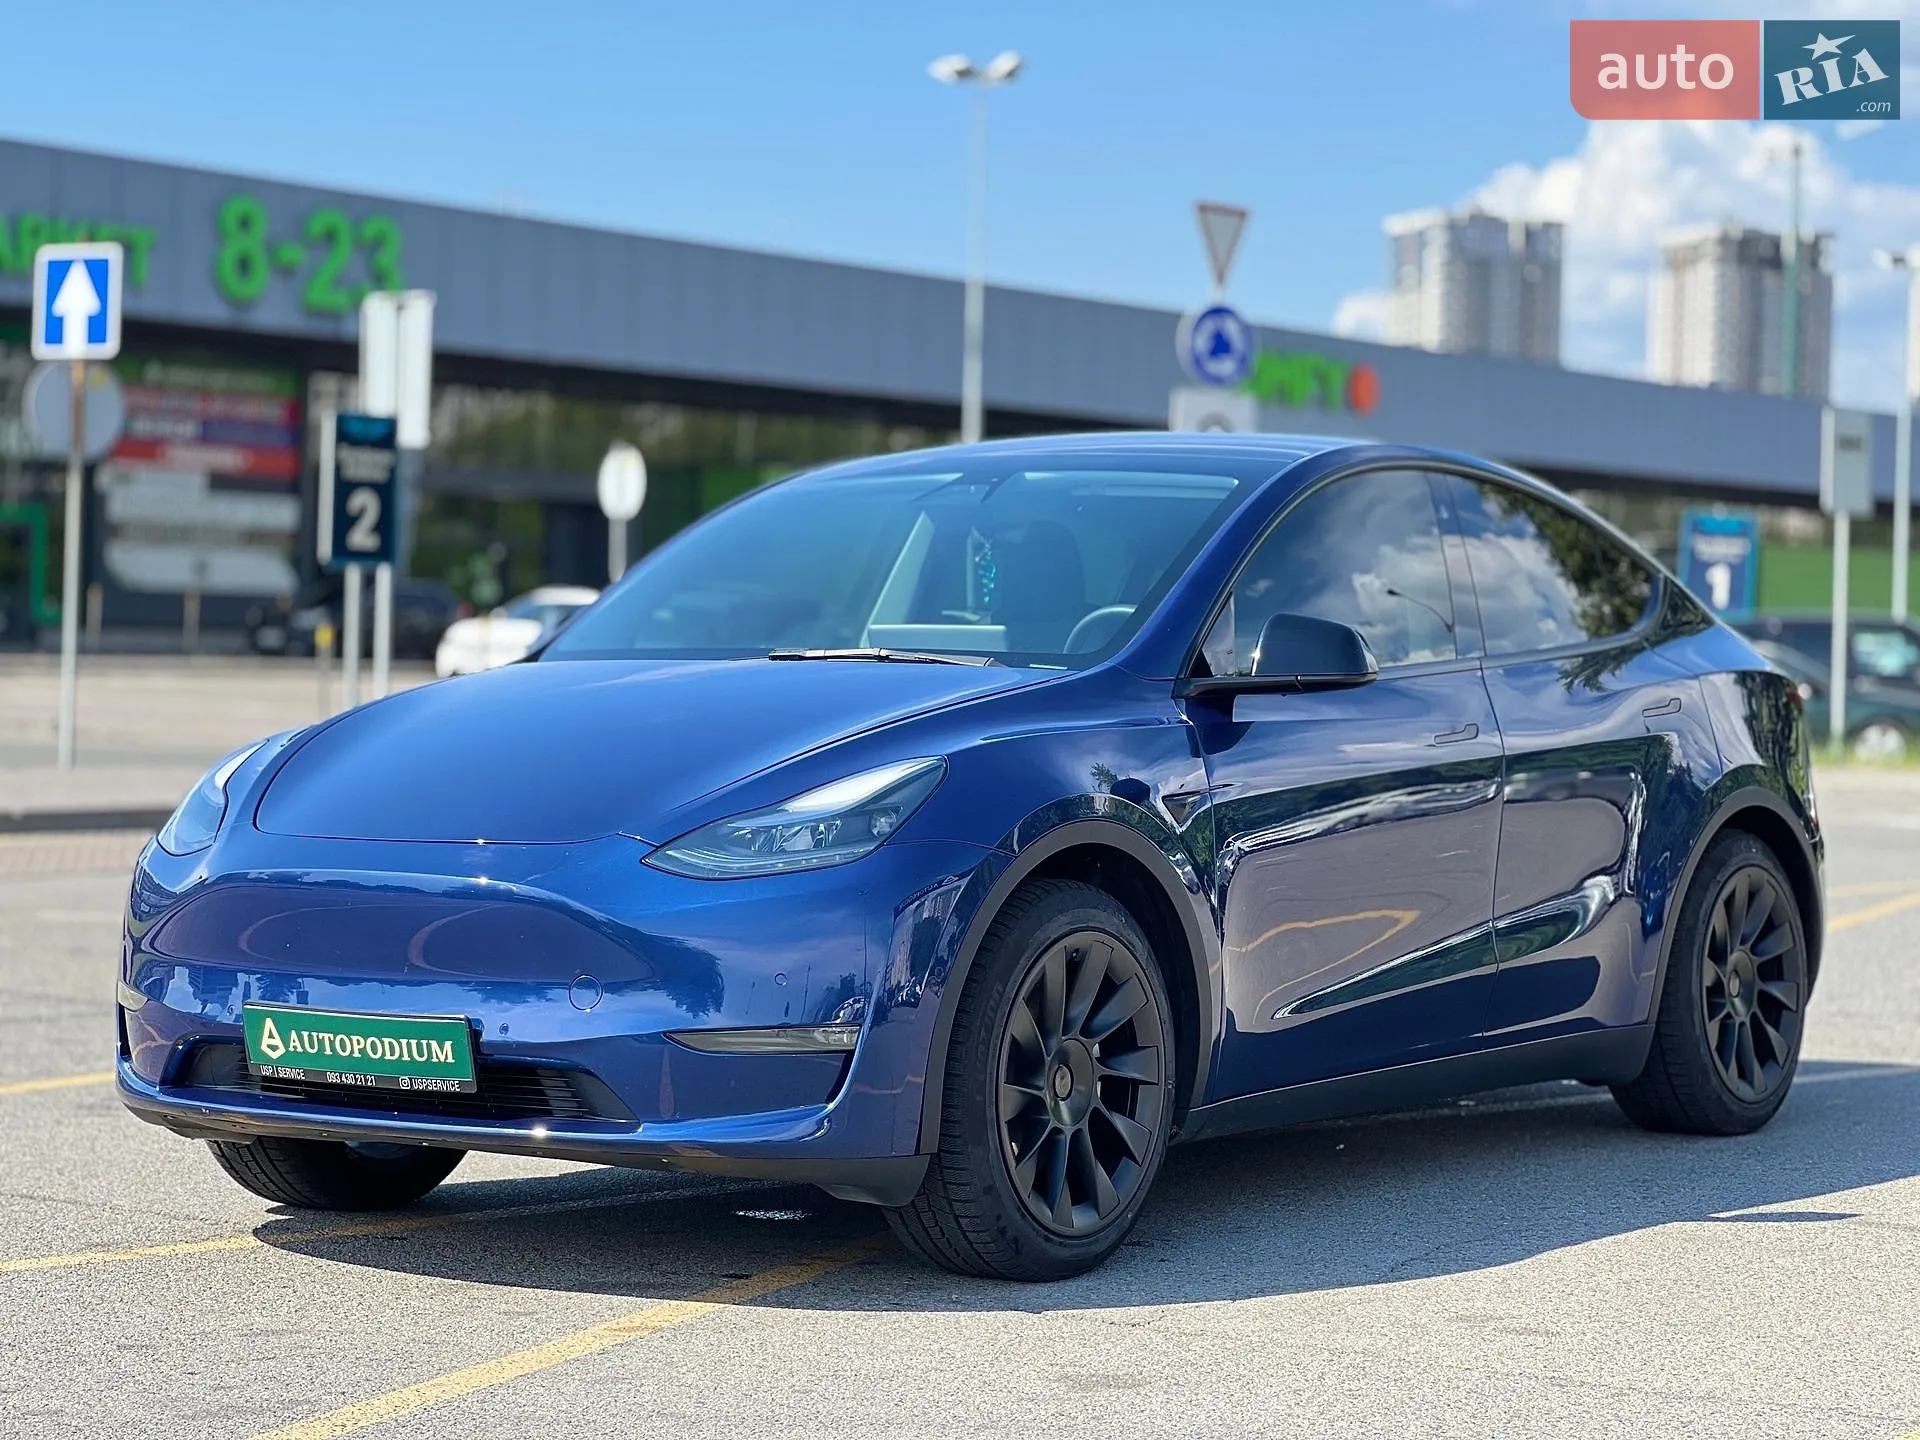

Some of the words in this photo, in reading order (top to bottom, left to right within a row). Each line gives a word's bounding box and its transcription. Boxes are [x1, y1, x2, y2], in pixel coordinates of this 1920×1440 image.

[217, 196, 402, 311] 8-23
[344, 486, 382, 552] 2
[1704, 562, 1732, 611] 1
[288, 1029, 456, 1063] AUTOPODIUM
[260, 1065, 273, 1076] USP
[278, 1066, 306, 1080] SERVICE
[326, 1072, 341, 1083] 093
[341, 1073, 355, 1085] 430
[355, 1074, 365, 1086] 21
[367, 1075, 376, 1087] 21
[412, 1078, 461, 1091] USPSERVICE
